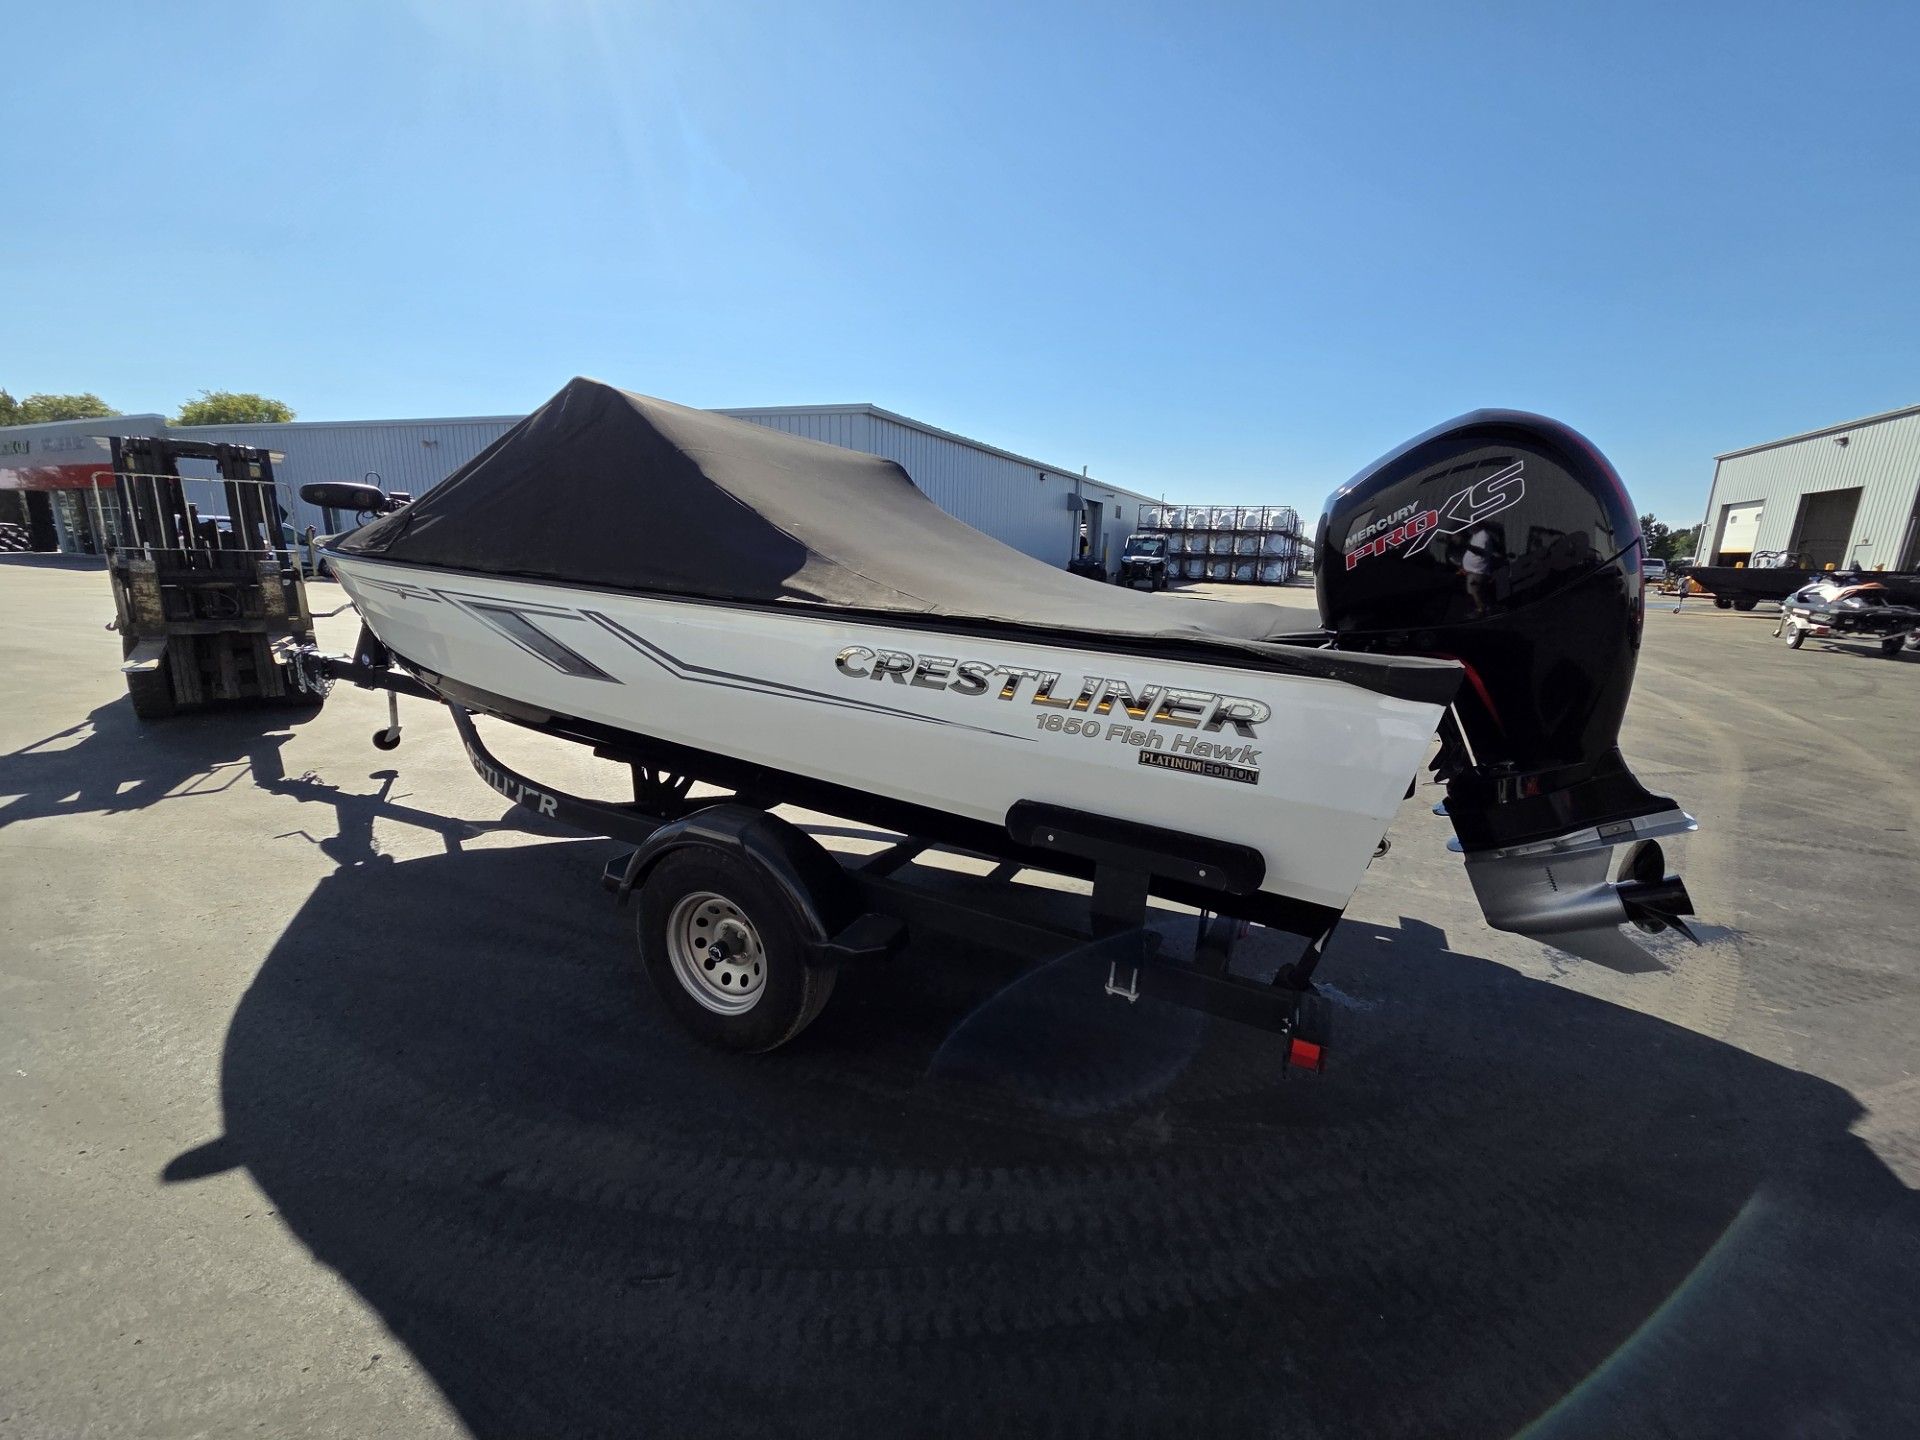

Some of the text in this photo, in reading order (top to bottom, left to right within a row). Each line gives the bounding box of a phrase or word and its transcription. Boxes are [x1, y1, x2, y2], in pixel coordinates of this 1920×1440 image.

[1345, 500, 1419, 548] MERCURY
[1346, 460, 1525, 571] PRO XS
[834, 645, 1271, 739] CRESTLINER
[1036, 713, 1263, 766] 1850 Fish Hawk
[1141, 752, 1260, 783] PLATINUM EDITION
